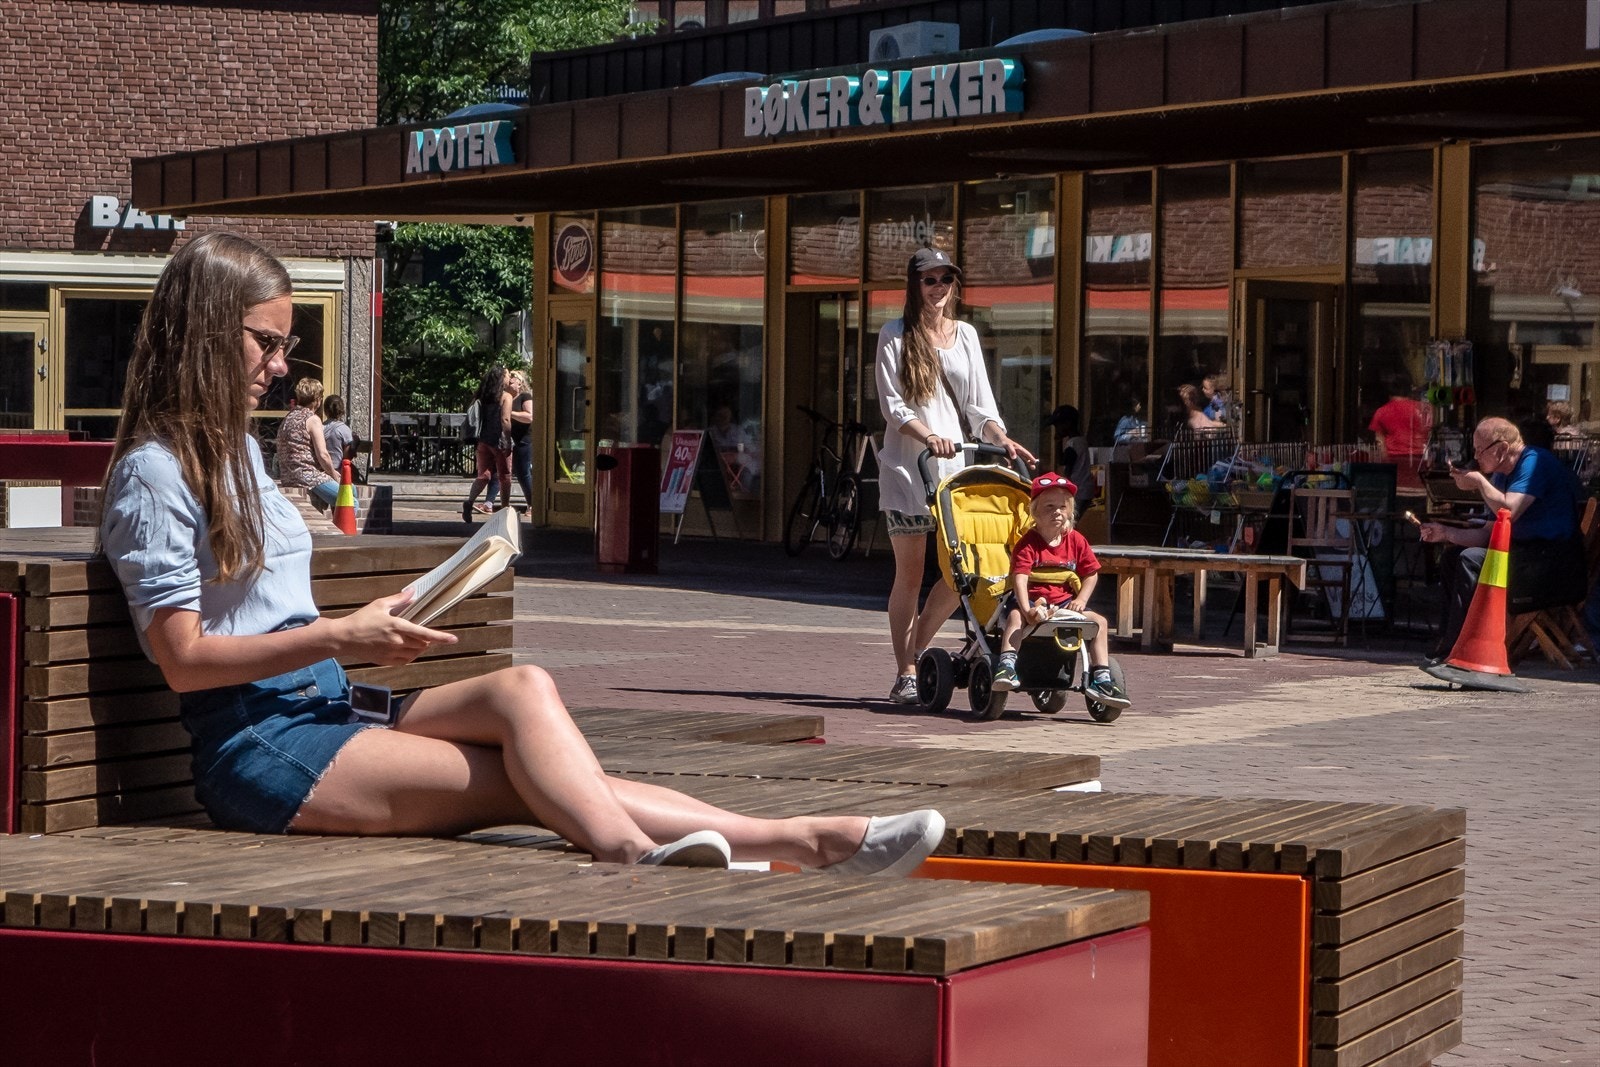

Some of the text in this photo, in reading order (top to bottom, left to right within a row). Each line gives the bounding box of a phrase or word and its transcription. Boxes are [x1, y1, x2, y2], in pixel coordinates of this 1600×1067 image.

[745, 58, 1006, 137] BØKER & LEKER
[406, 121, 499, 174] APOTEK
